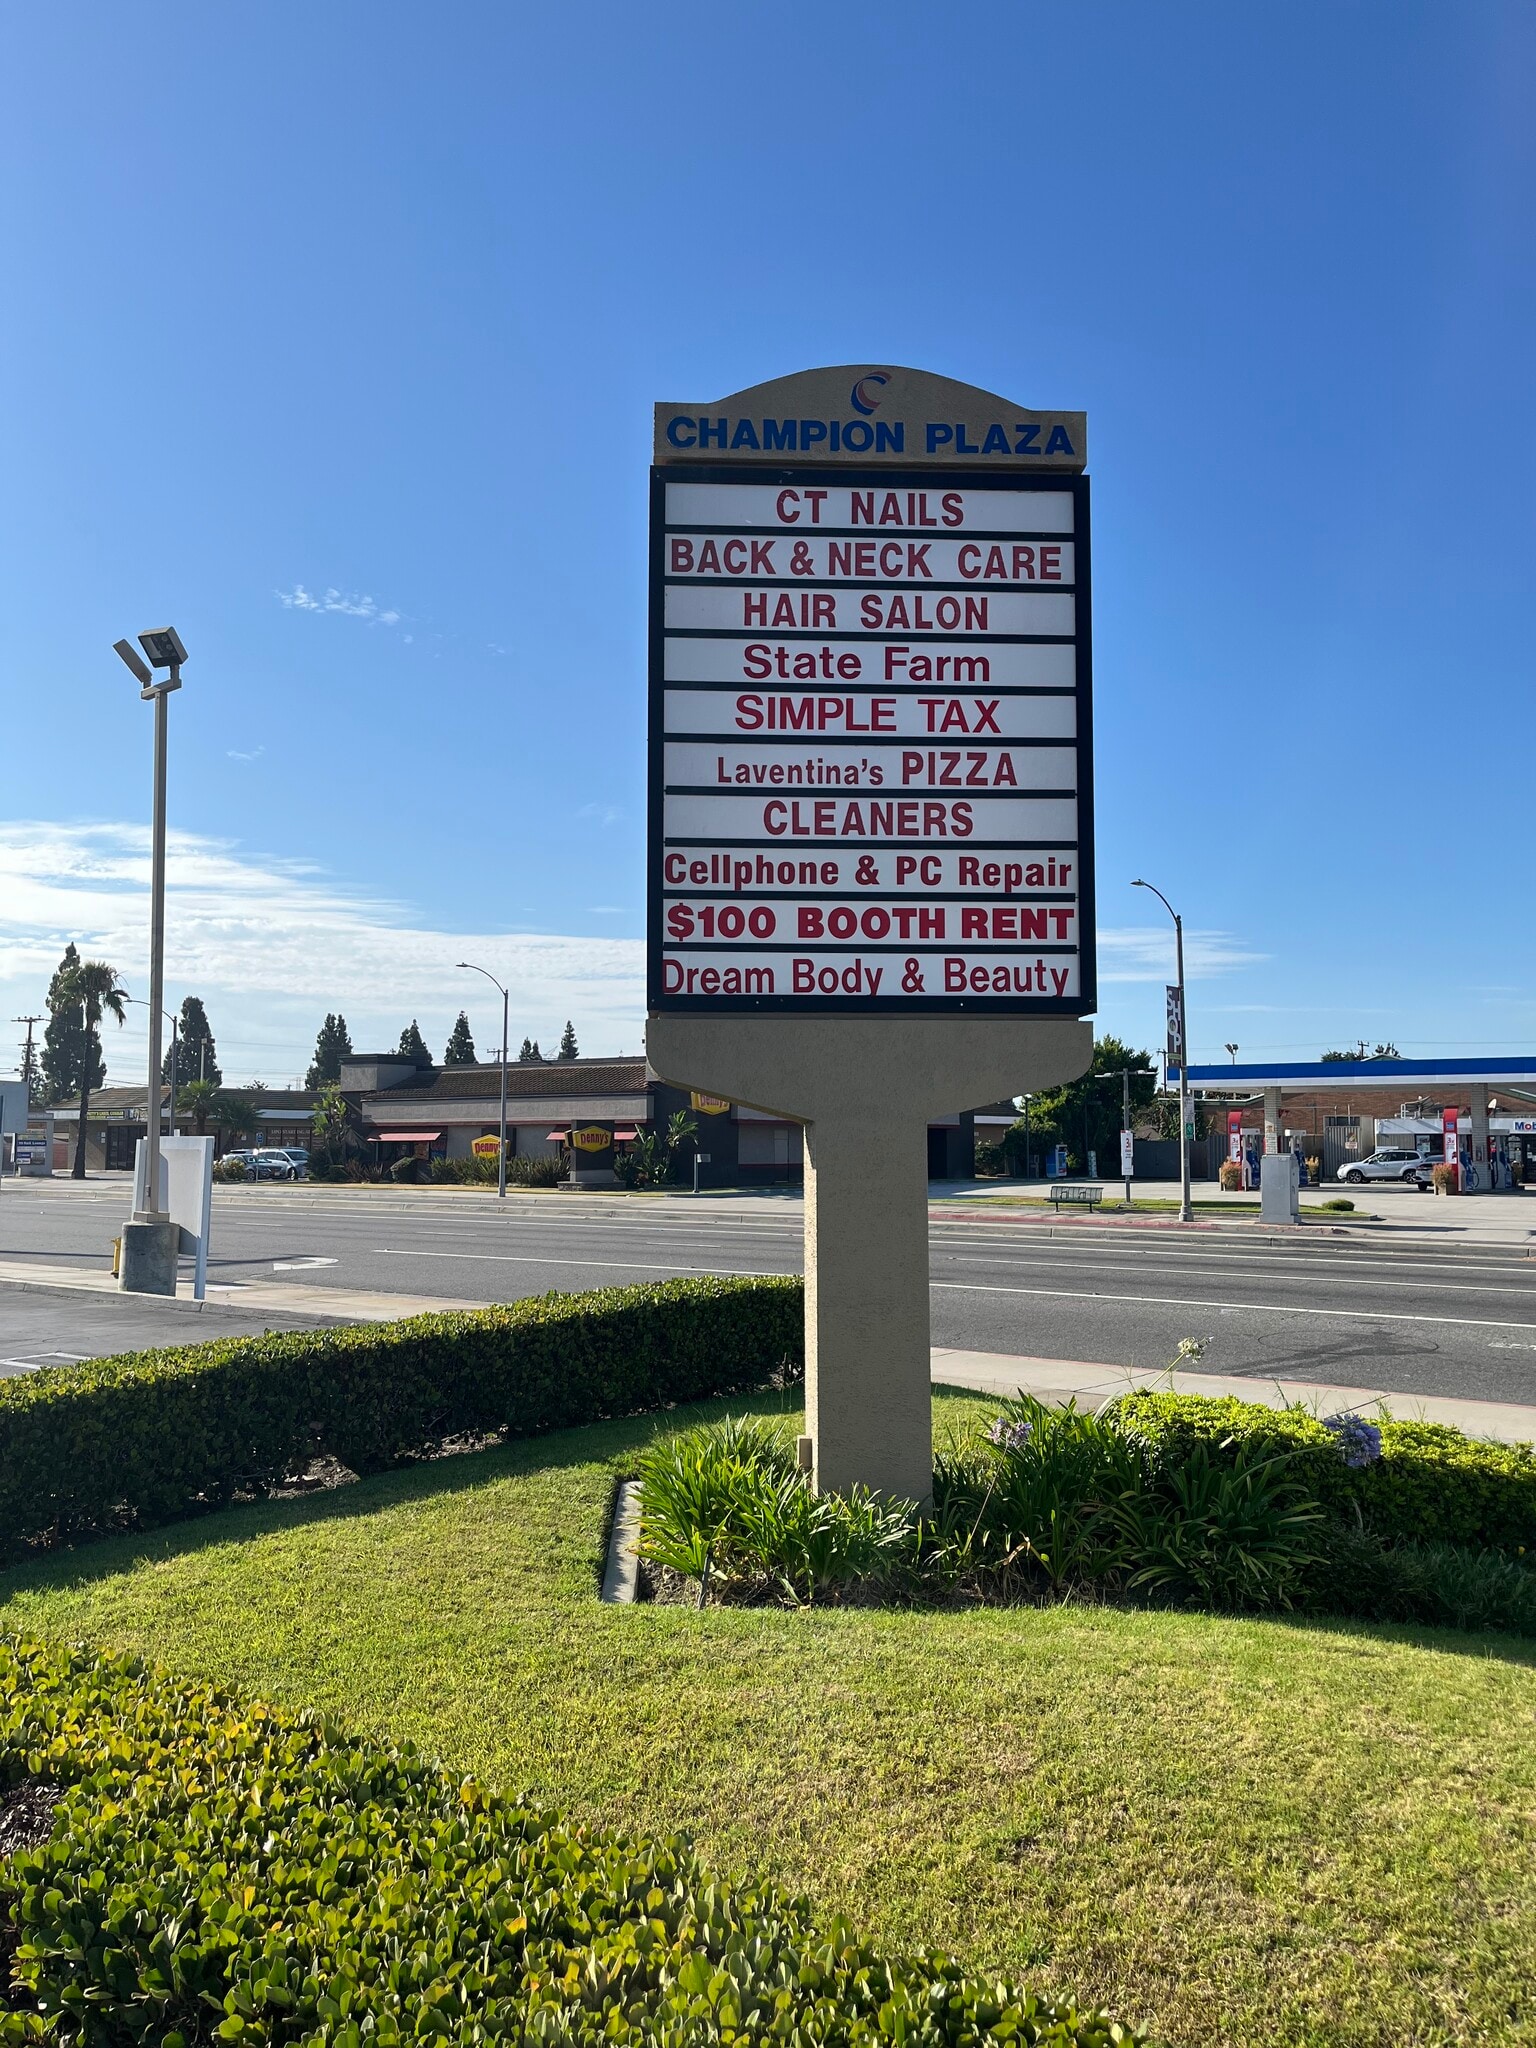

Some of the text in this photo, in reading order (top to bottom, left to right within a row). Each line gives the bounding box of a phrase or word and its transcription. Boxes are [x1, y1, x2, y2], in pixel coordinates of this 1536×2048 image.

[666, 416, 1076, 455] CHAMPION PLAZA
[776, 489, 965, 527] CT NAILS
[671, 538, 1063, 580] BACK & NECK CARE
[743, 592, 989, 631] HAIR SALON
[742, 643, 991, 682] State Farm
[734, 694, 1002, 734] SIMPLE TAX
[717, 751, 1018, 787] Laventina's PIZZA
[763, 799, 974, 837] CLEANERS
[664, 853, 1072, 893] Cellphone & PC Repair
[666, 902, 1075, 942] $100 BOOTH RENT
[663, 957, 1070, 998] Dream Body & Beauty
[1167, 990, 1181, 1052] SHOP
[474, 1142, 500, 1154] Denny'
[580, 1131, 609, 1146] Denny's
